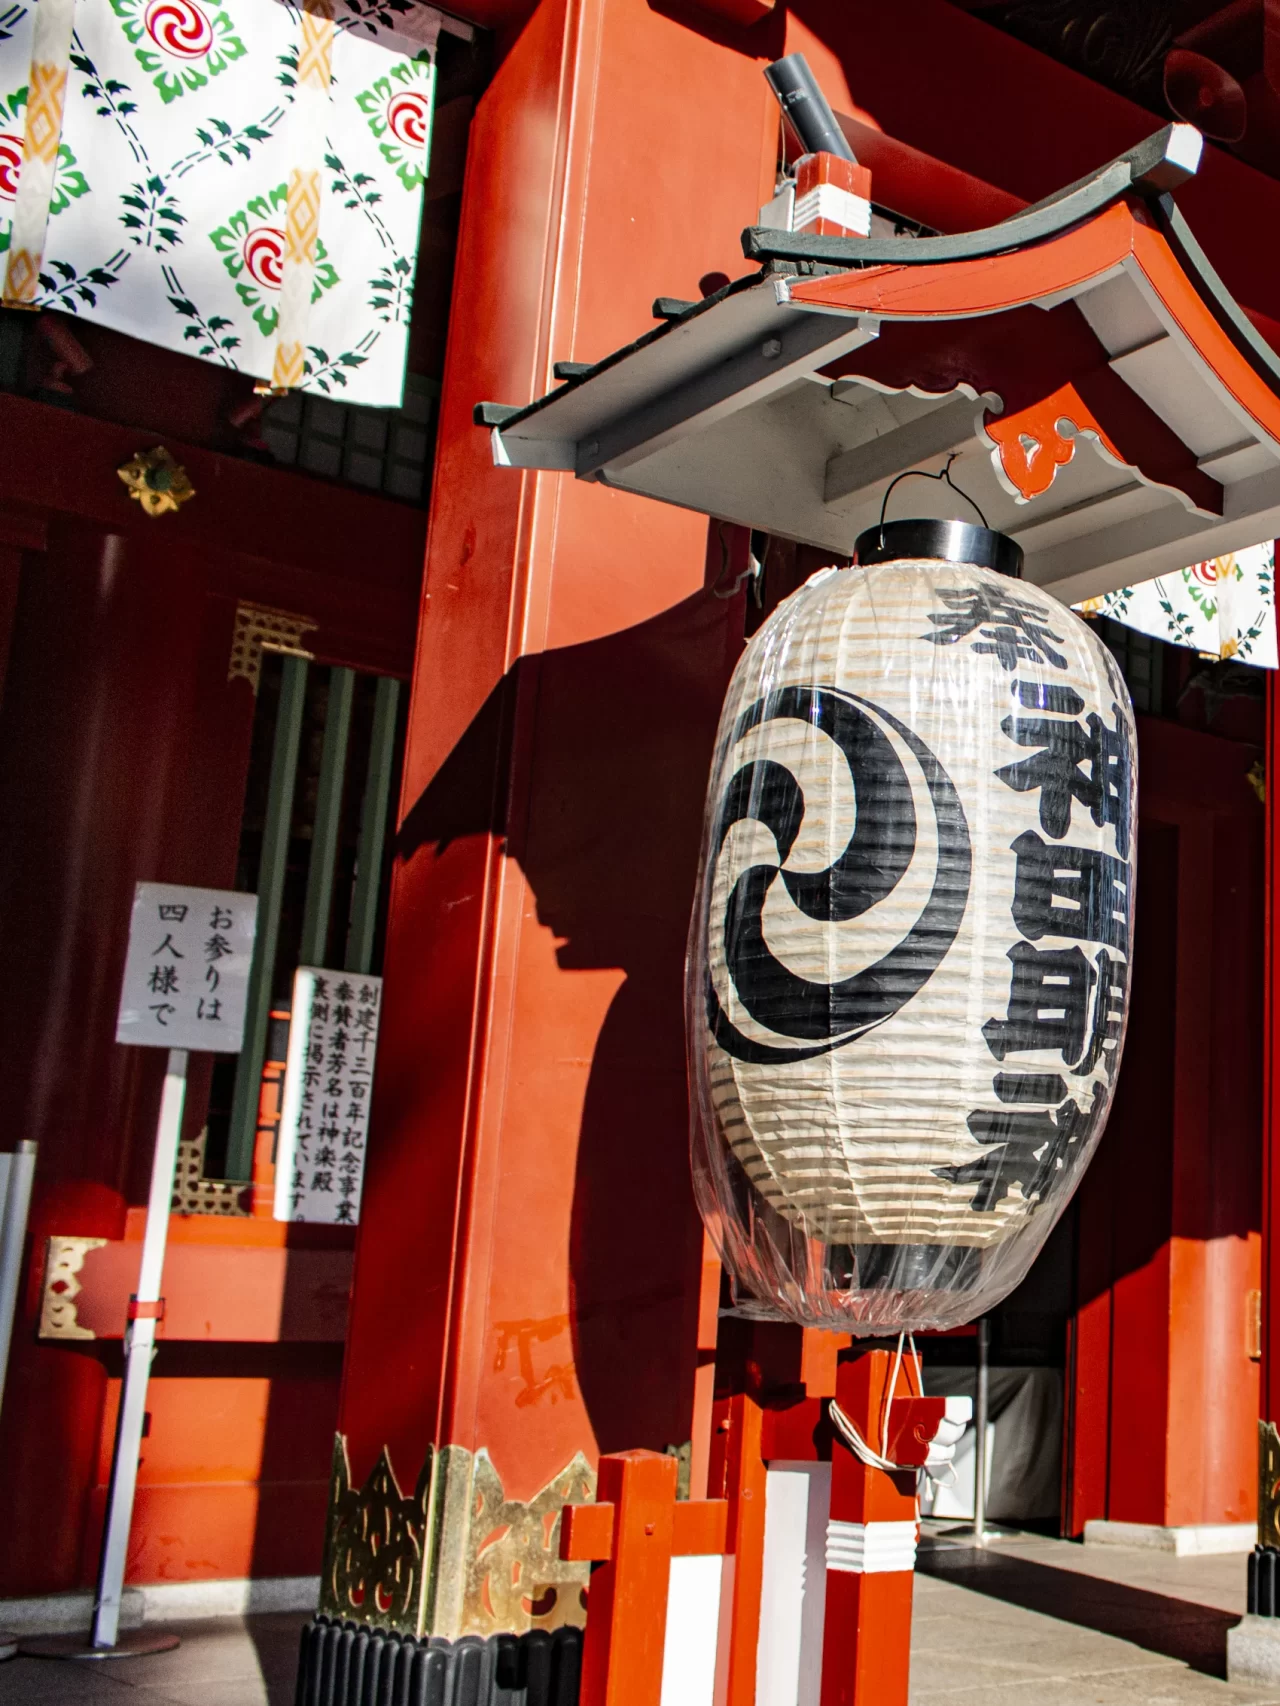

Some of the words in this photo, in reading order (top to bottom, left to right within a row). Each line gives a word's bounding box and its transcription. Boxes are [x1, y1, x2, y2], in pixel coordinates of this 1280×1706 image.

[147, 903, 189, 1026] 四人様で
[196, 905, 233, 1021] お参りは
[335, 983, 379, 1225] 創建千三百年記念事業
